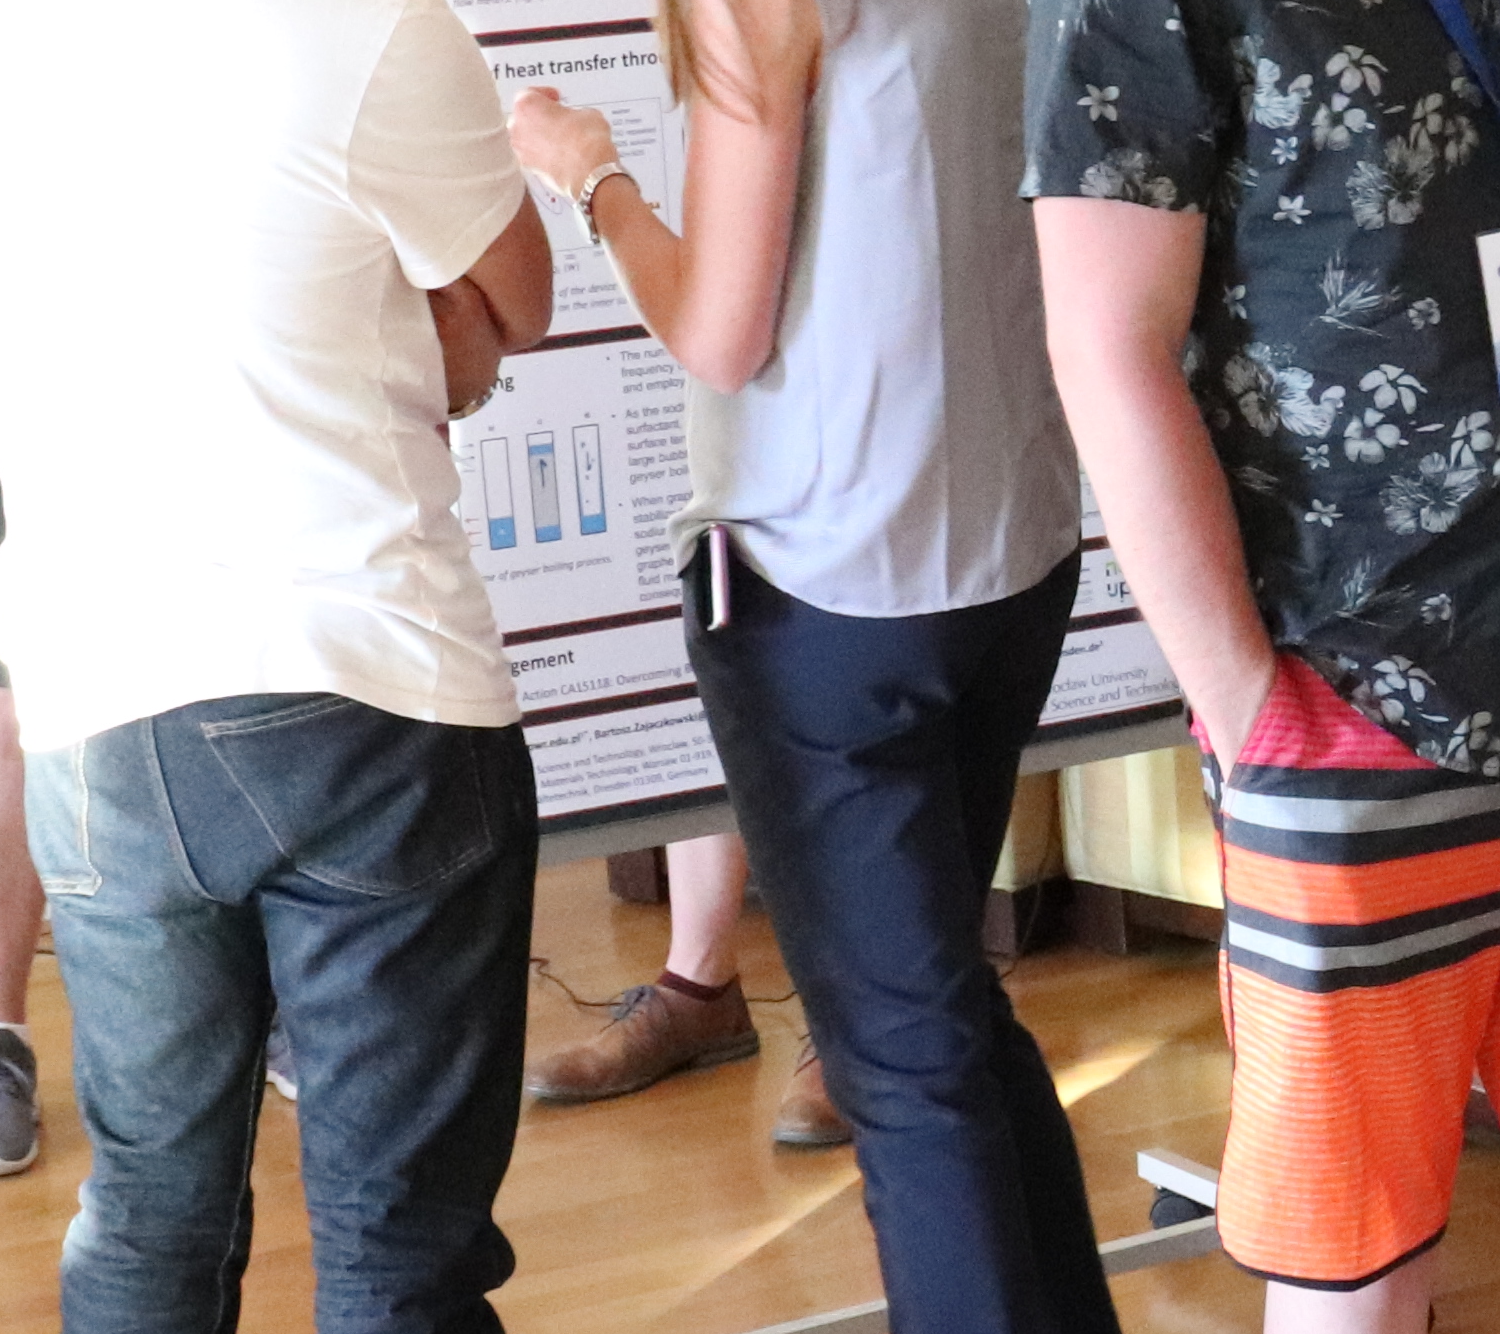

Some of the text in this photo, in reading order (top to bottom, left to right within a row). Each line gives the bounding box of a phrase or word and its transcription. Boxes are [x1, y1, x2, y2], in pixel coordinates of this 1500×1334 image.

[505, 51, 660, 79] heat transfer thro
